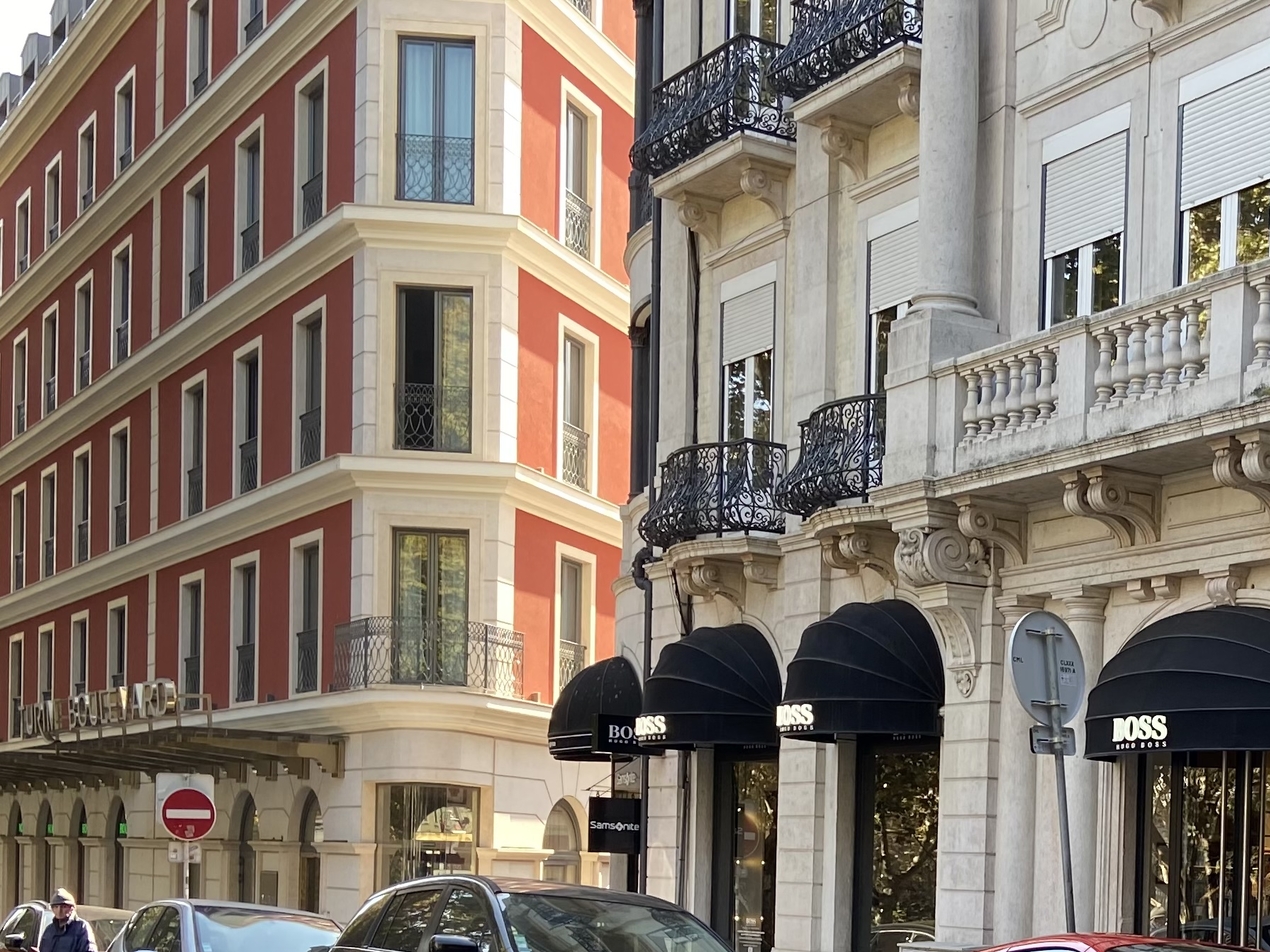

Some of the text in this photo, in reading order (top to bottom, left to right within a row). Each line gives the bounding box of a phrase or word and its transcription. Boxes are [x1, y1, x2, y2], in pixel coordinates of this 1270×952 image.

[67, 678, 177, 731] BOULEVARD
[608, 724, 636, 740] BO
[1111, 714, 1168, 742] BOSS
[589, 820, 640, 831] Samsonite
